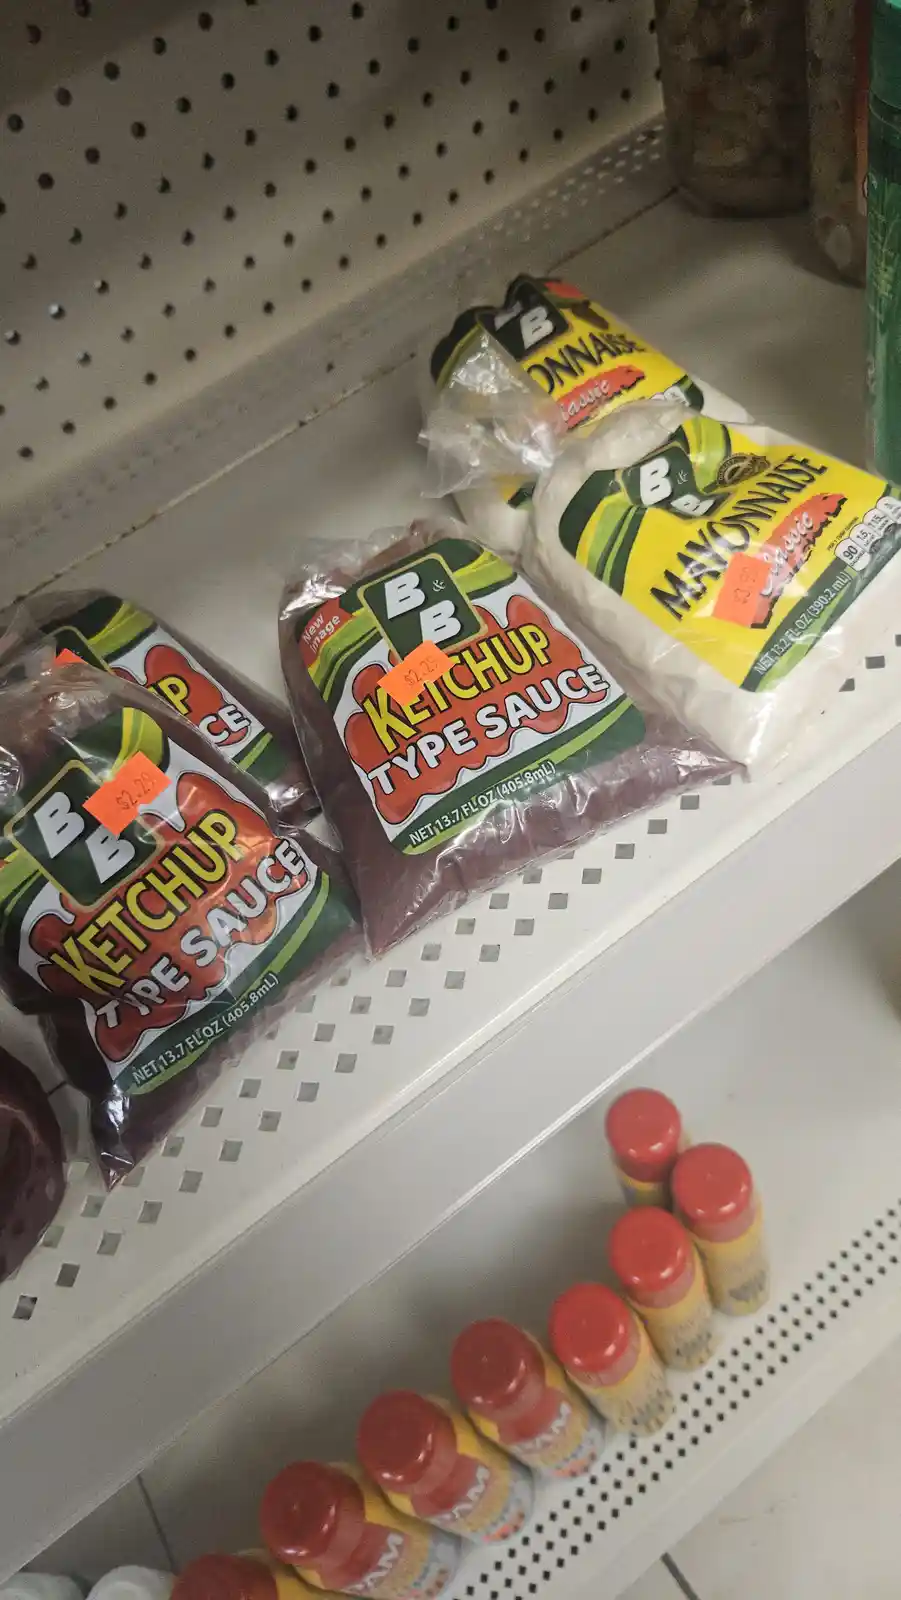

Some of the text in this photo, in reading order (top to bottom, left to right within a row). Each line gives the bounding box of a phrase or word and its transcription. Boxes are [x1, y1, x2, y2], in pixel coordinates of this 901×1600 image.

[560, 380, 610, 422] lassic
[639, 458, 673, 506] B
[650, 454, 828, 621] MAYONNAISE
[842, 545, 858, 560] 90
[302, 612, 324, 645] New
[384, 571, 462, 644] B & B
[367, 663, 611, 795] TYPE SAUCE
[33, 791, 136, 884] B B
[408, 761, 556, 845] NET 13.7 FL OZ (405.8mL)
[50, 812, 244, 996] KETCHUP
[180, 838, 306, 968] SAUCE
[132, 1059, 159, 1084] NET
[158, 1043, 186, 1067] 13.7
[202, 1020, 224, 1039] OZ
[222, 973, 279, 1027] (405.8mL)
